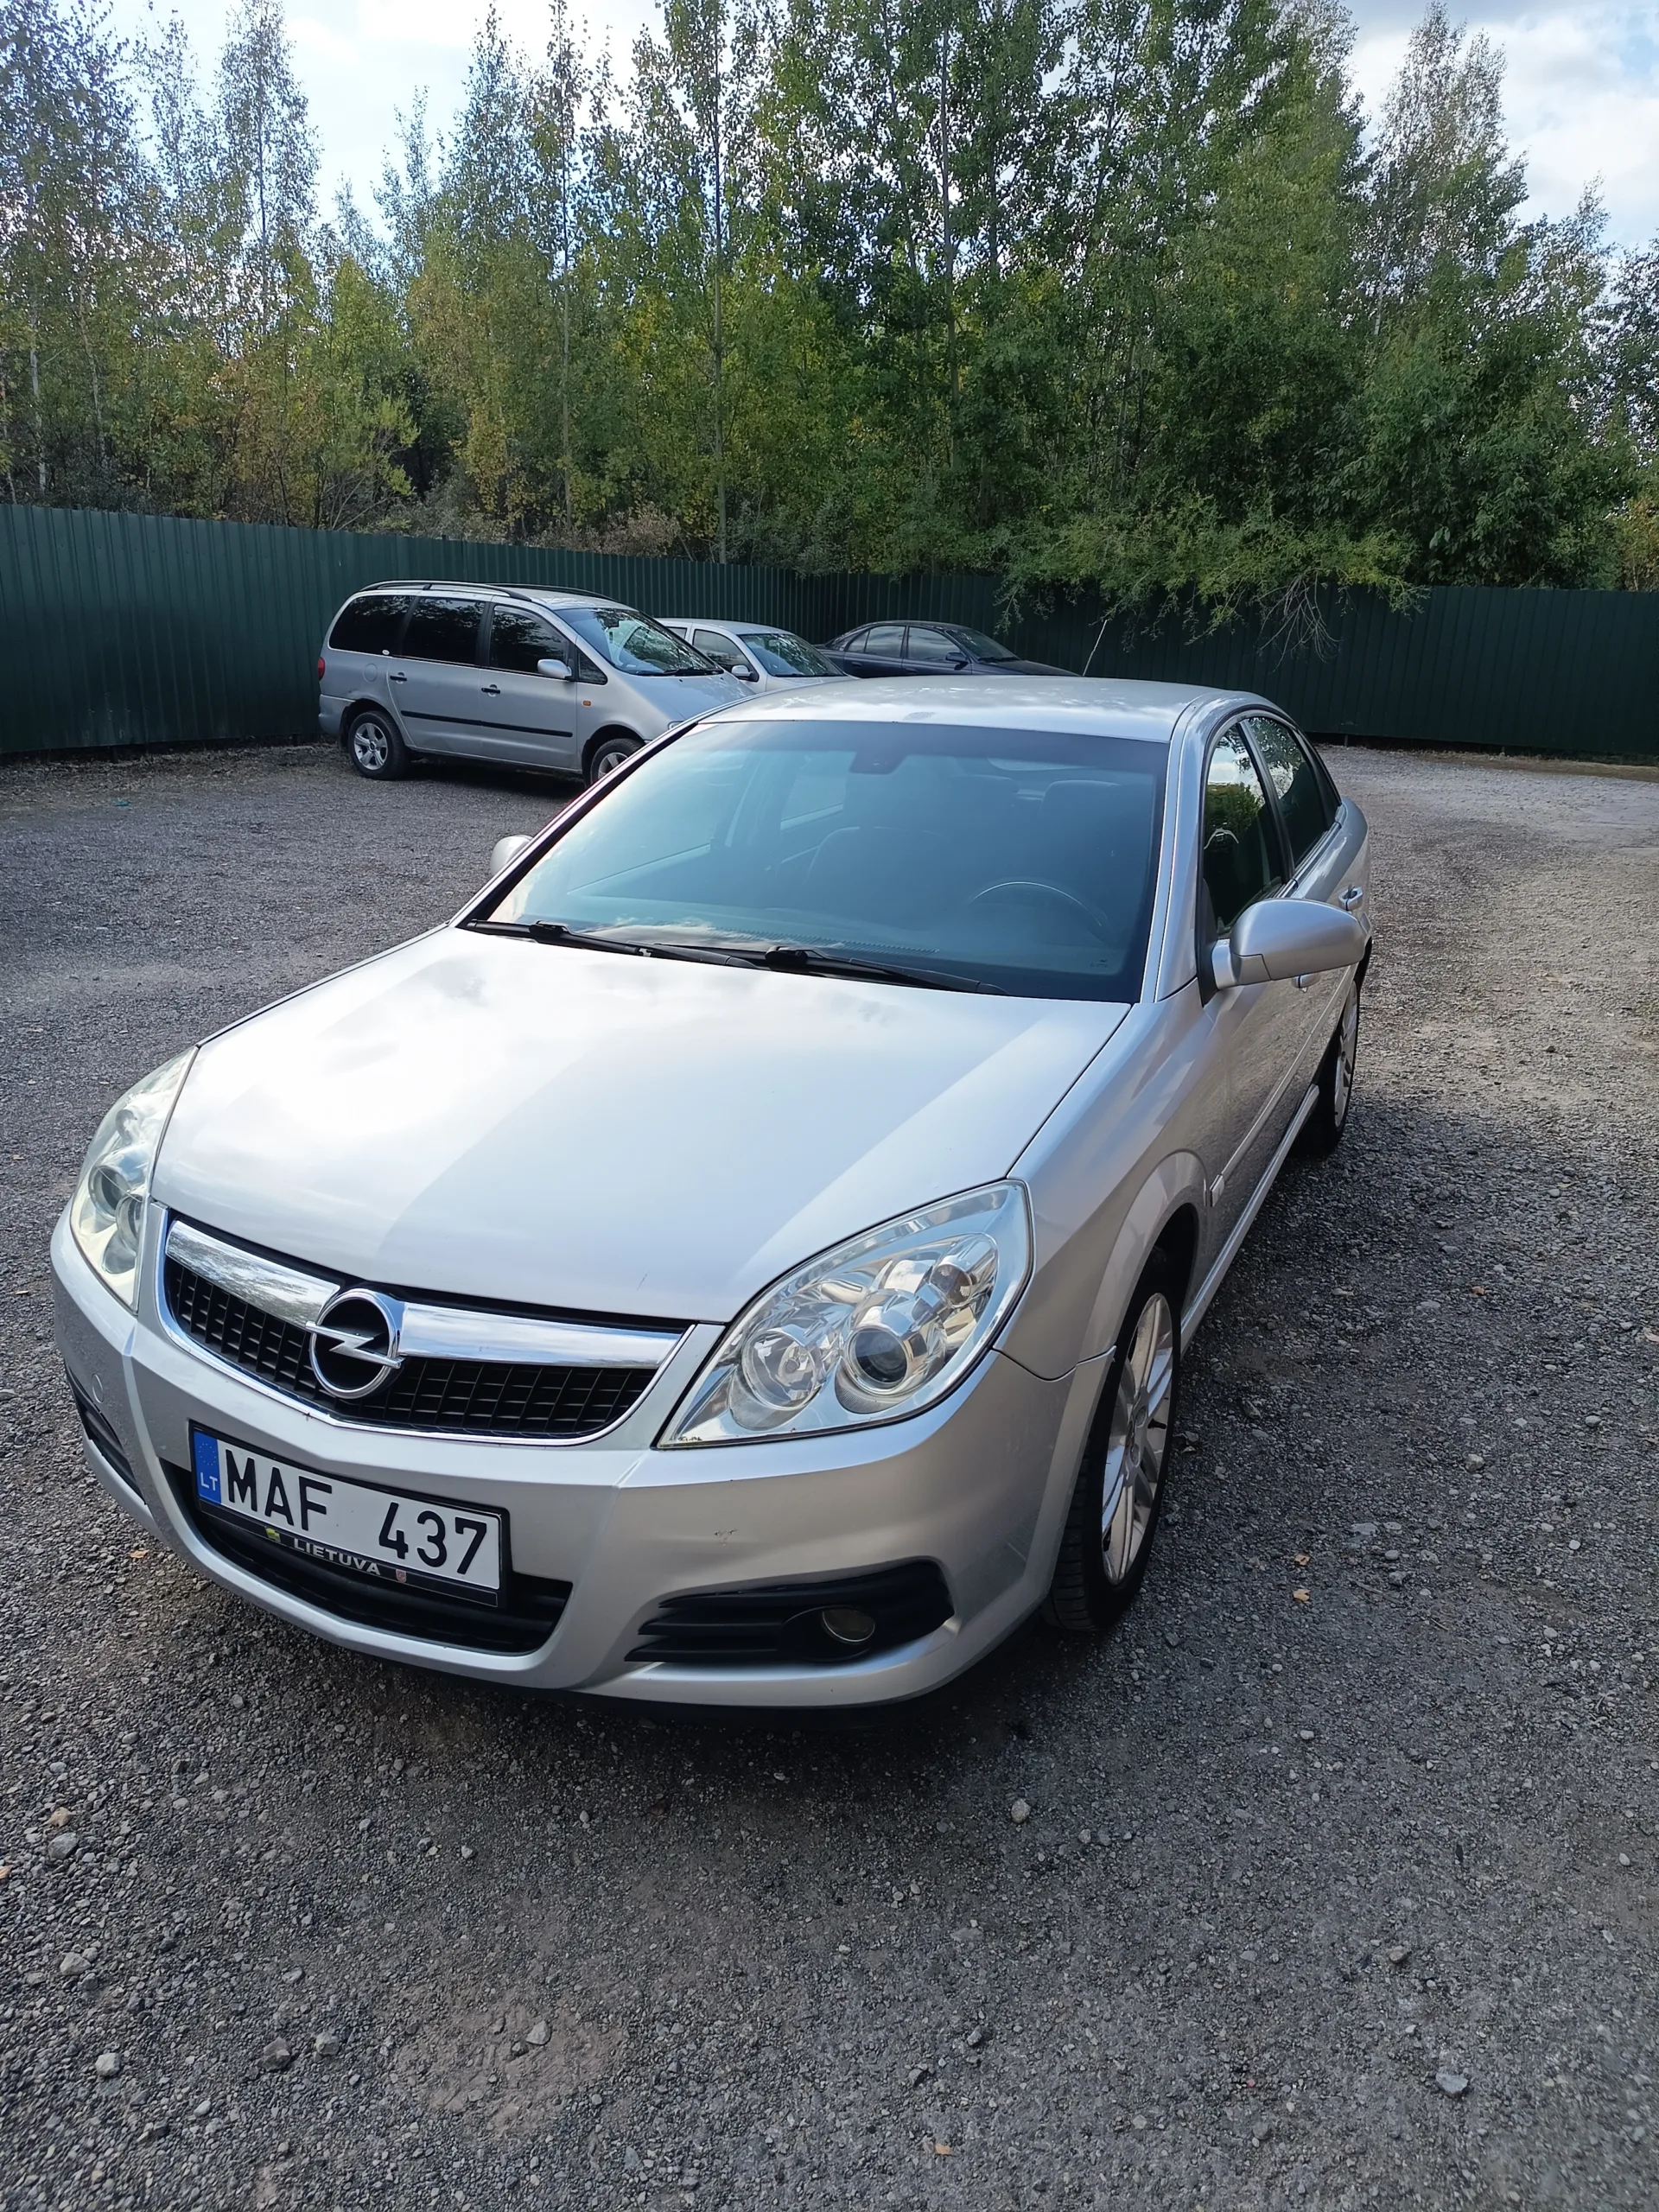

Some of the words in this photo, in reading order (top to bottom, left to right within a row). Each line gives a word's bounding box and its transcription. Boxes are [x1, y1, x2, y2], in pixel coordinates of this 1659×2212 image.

[200, 1471, 219, 1491] LT
[226, 1448, 333, 1532] MAF
[378, 1502, 487, 1575] 437
[294, 1537, 381, 1575] LIETUVA
